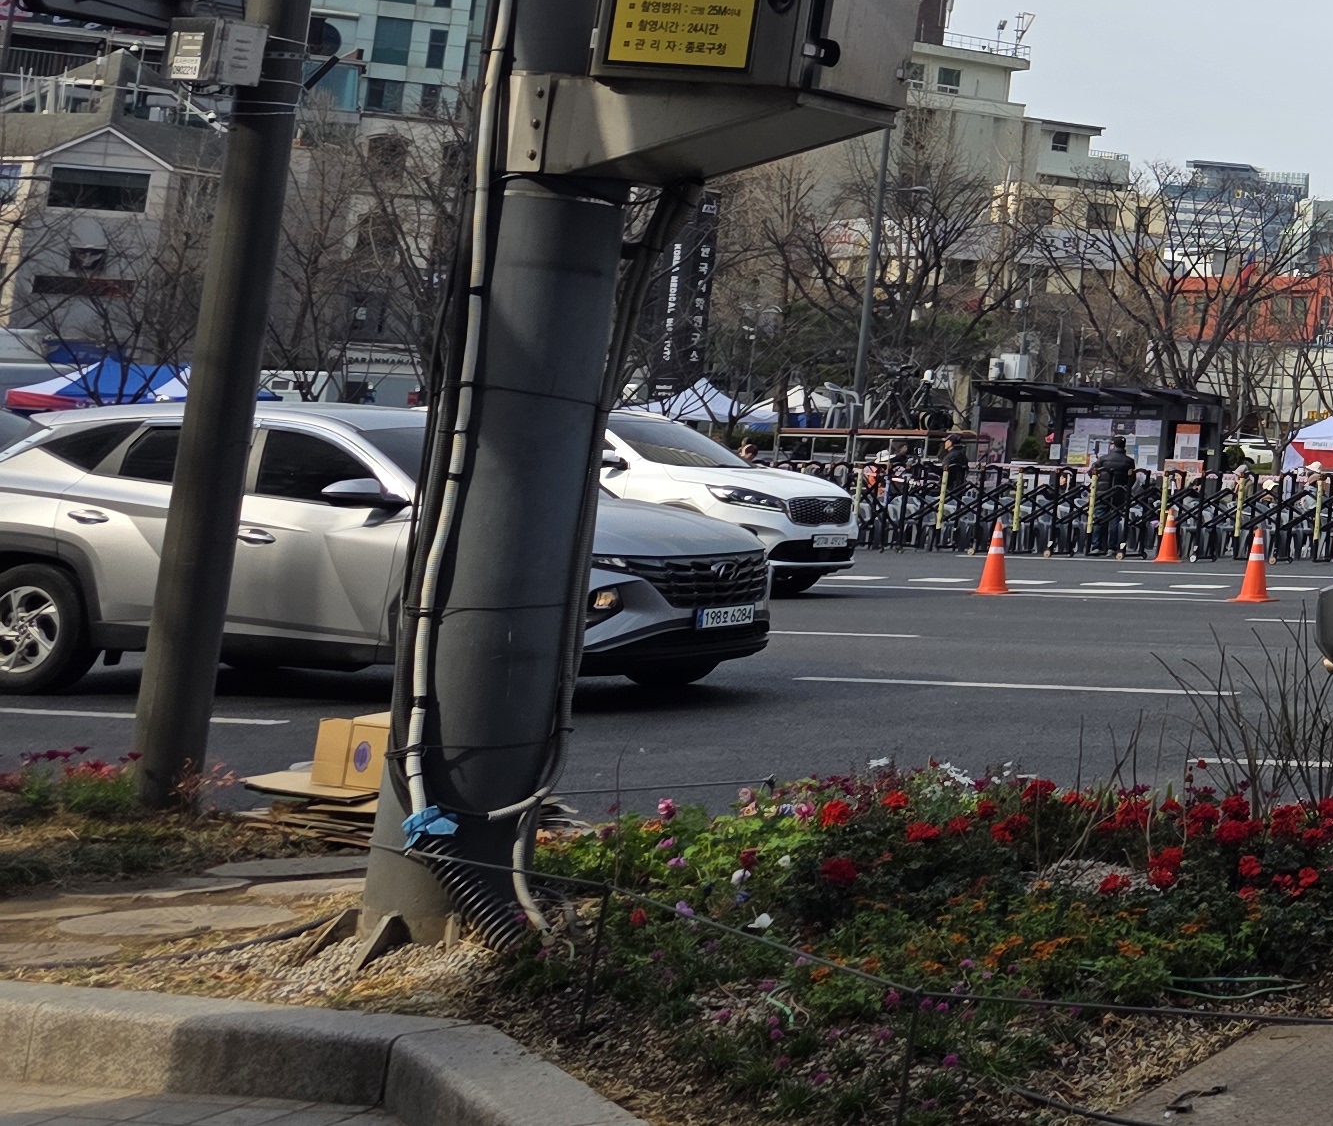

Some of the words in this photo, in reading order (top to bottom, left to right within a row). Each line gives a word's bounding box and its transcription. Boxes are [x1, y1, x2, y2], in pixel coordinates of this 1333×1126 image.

[641, 0, 682, 14] 촬영범위
[638, 19, 679, 33] 촬영시간
[687, 23, 719, 35] 24시간
[685, 40, 727, 55] 종로구청
[667, 275, 678, 314] MEDICAL
[730, 607, 752, 622] 6284
